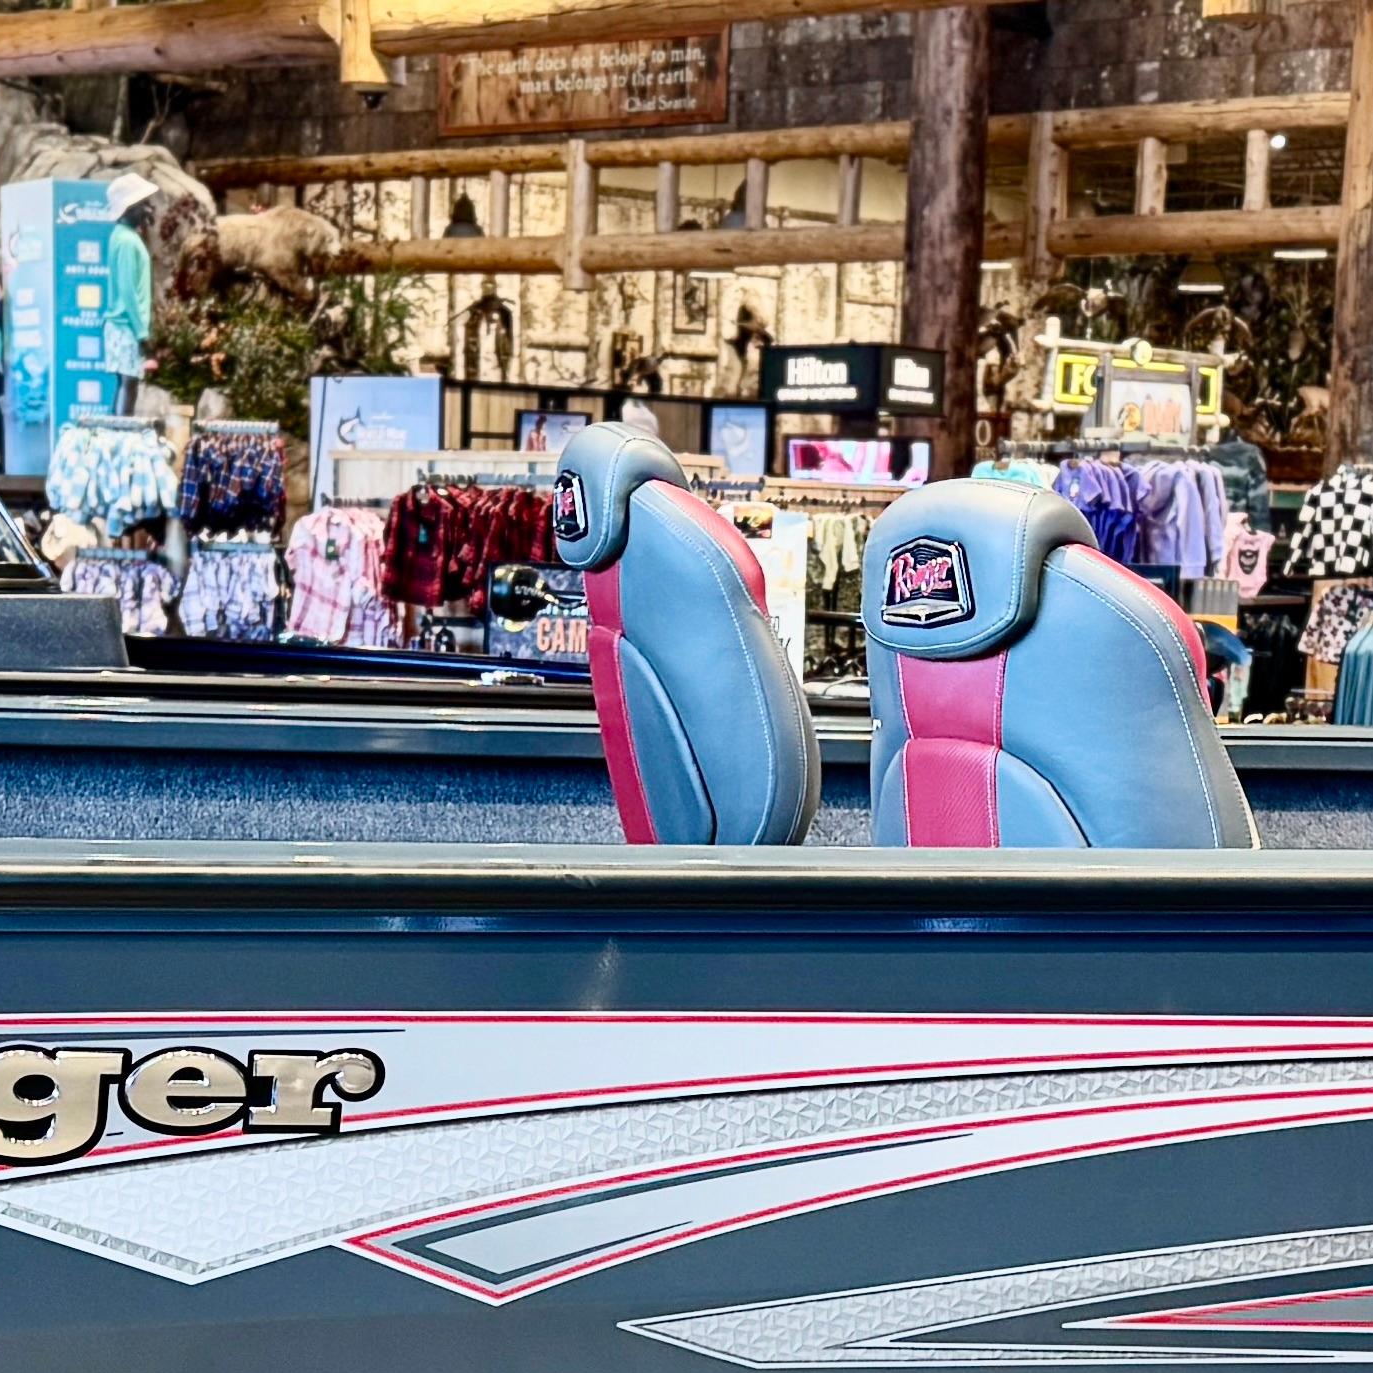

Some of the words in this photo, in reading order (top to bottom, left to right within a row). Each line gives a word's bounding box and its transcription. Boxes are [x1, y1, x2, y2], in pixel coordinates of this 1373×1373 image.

[497, 55, 530, 76] earth
[534, 53, 568, 73] does
[570, 53, 595, 70] not
[598, 49, 646, 72] belong
[651, 50, 666, 65] to
[519, 78, 552, 95] man
[554, 73, 609, 97] belongs
[611, 72, 627, 88] to
[631, 68, 654, 87] the
[786, 355, 849, 386] Hilton
